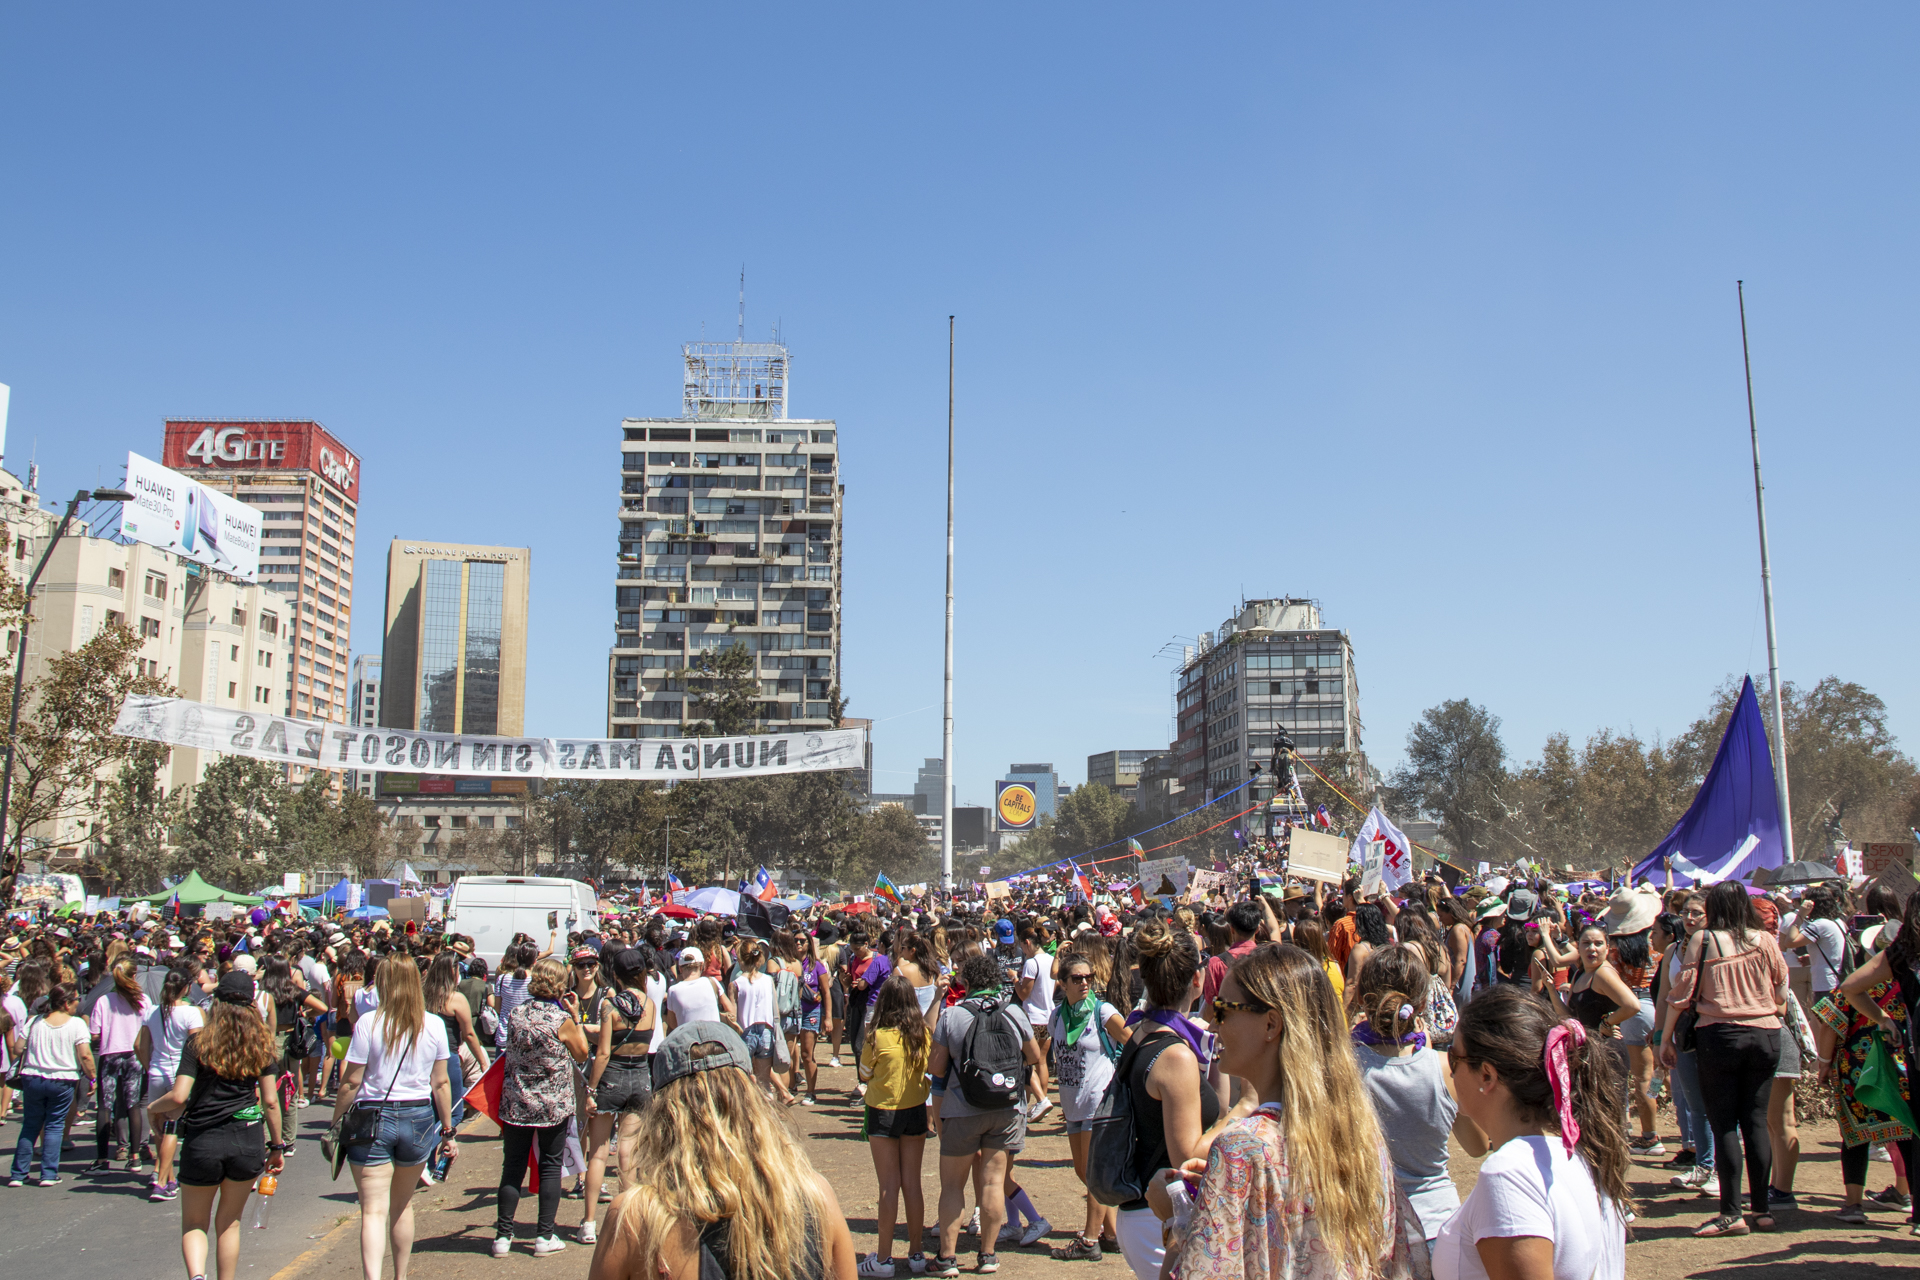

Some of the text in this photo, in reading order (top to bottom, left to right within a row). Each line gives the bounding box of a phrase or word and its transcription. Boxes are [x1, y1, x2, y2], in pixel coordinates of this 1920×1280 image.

[319, 446, 351, 490] Claro
[135, 475, 175, 503] HUAWEI
[133, 492, 162, 513] Mate30
[163, 503, 174, 518] Pro
[225, 513, 257, 538] HUAWEI
[224, 530, 256, 552] MateBook D
[417, 547, 519, 561] CROWNE PLAZA HOTEL
[1004, 798, 1031, 813] CAPITALS
[1015, 794, 1023, 803] BE
